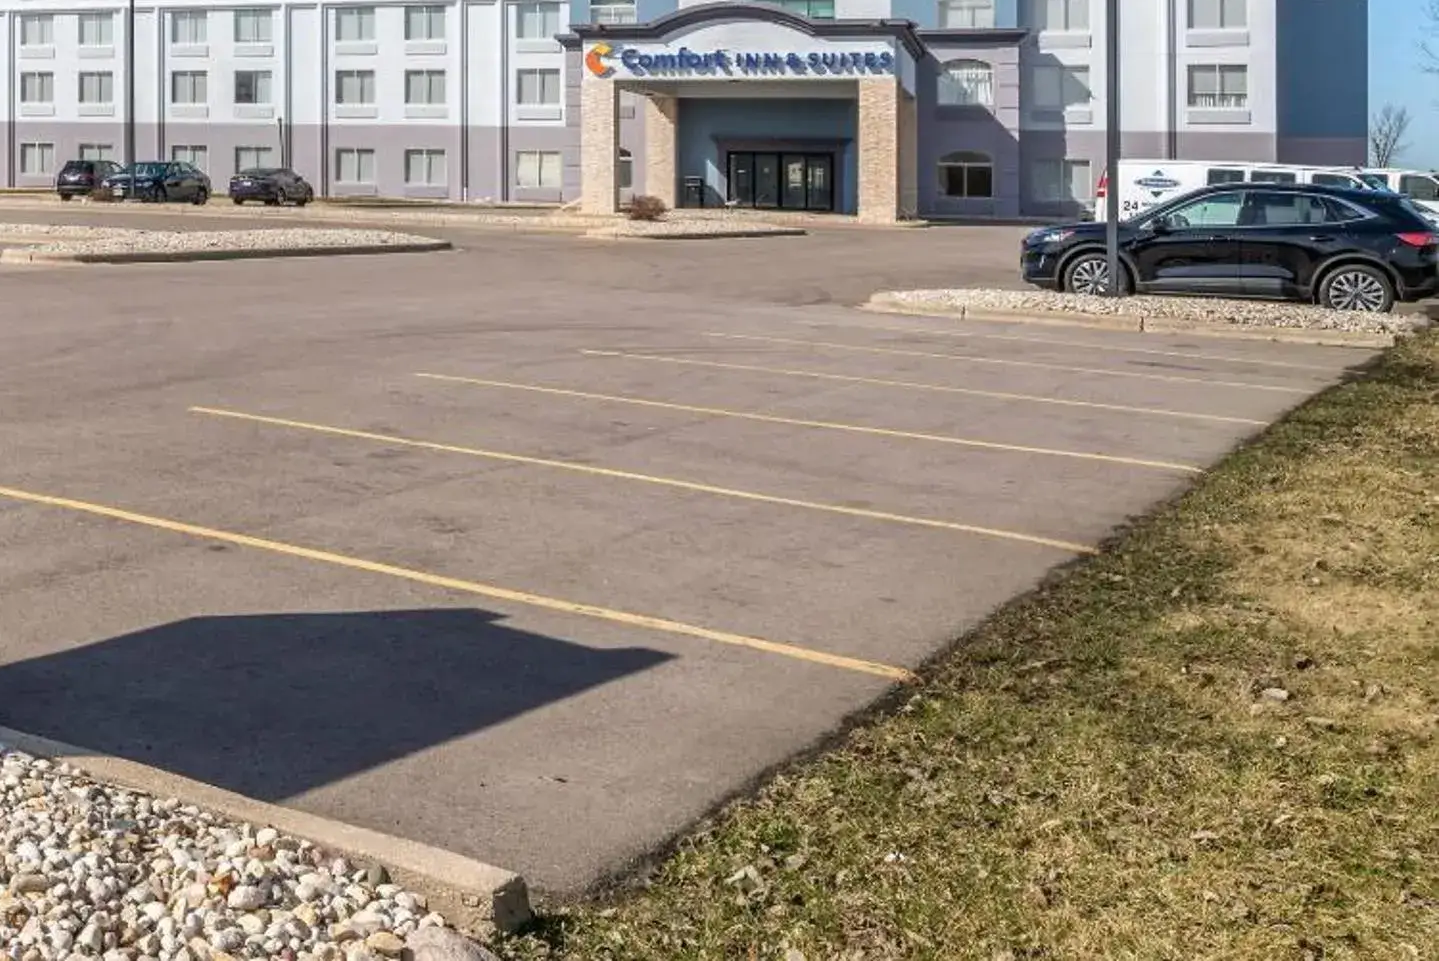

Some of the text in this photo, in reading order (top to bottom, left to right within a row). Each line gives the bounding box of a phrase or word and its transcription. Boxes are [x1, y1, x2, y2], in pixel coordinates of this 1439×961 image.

[621, 47, 893, 70] Comfort INN & SUITES
[1123, 200, 1139, 211] 24
